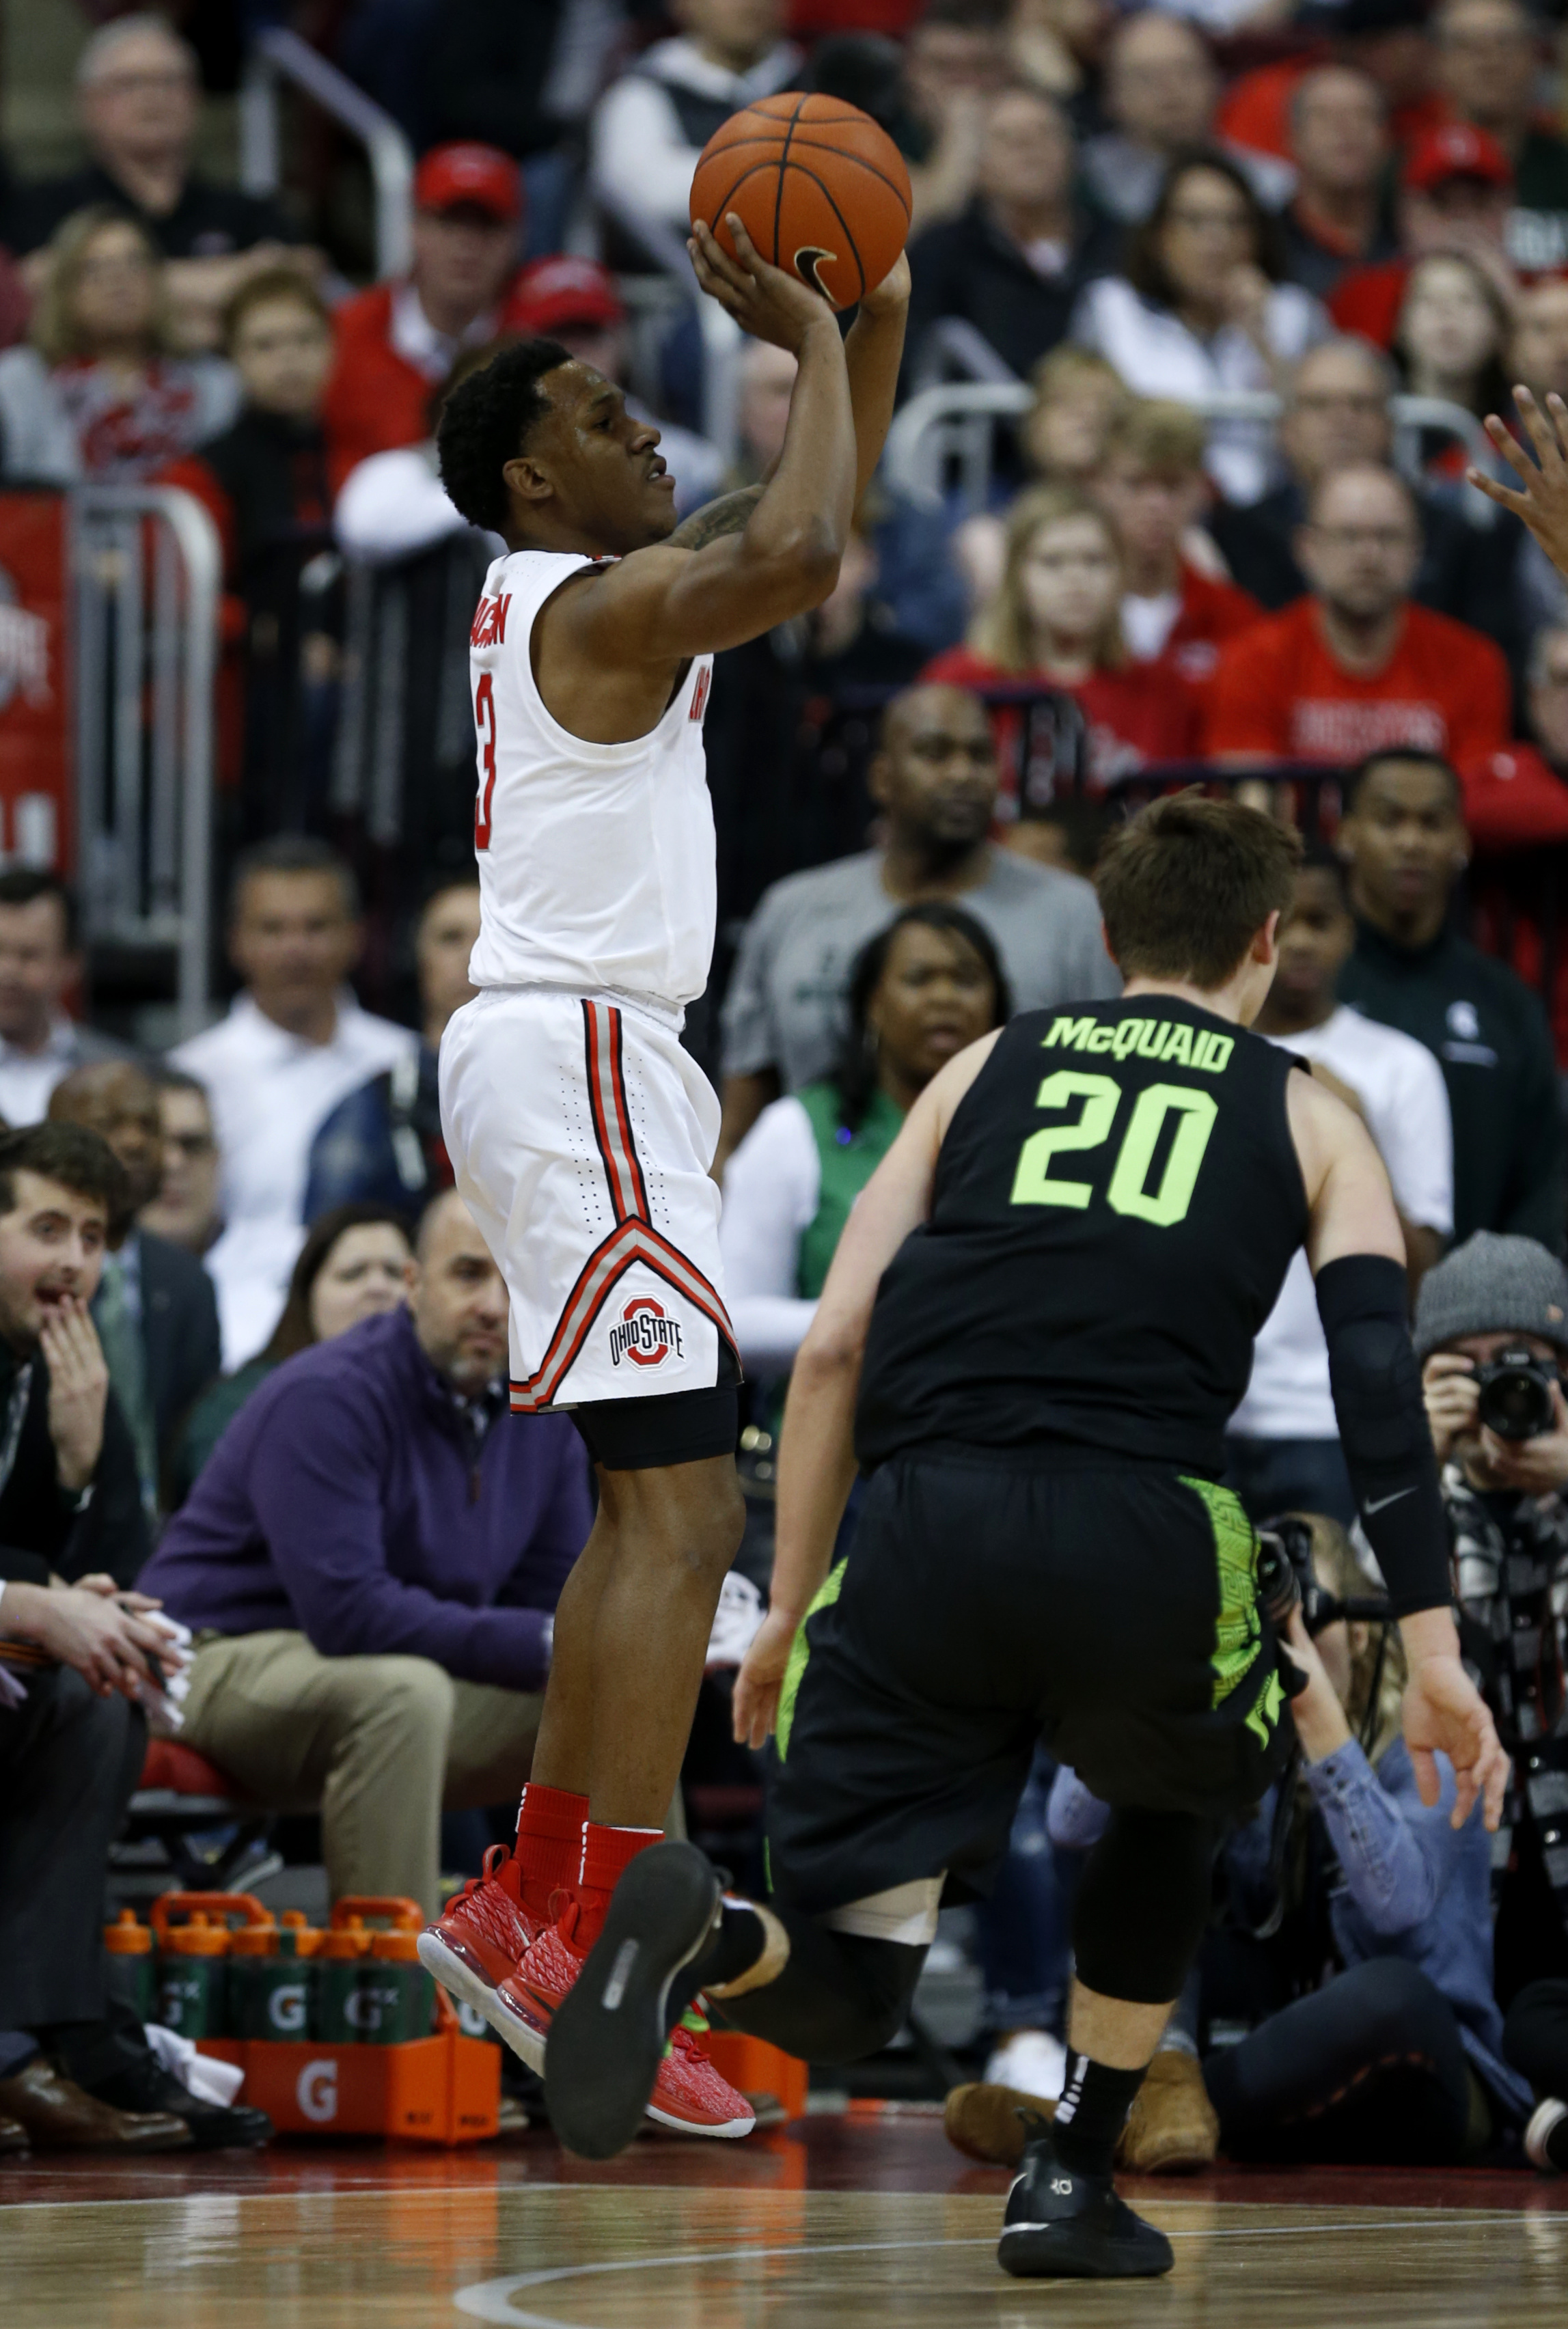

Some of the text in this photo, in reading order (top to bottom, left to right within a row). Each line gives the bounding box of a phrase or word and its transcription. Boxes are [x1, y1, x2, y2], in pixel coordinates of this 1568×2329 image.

[1040, 1017, 1235, 1073] McQUAID
[1010, 1070, 1219, 1227] 20
[269, 1984, 306, 2030] G
[297, 2059, 338, 2122] G
